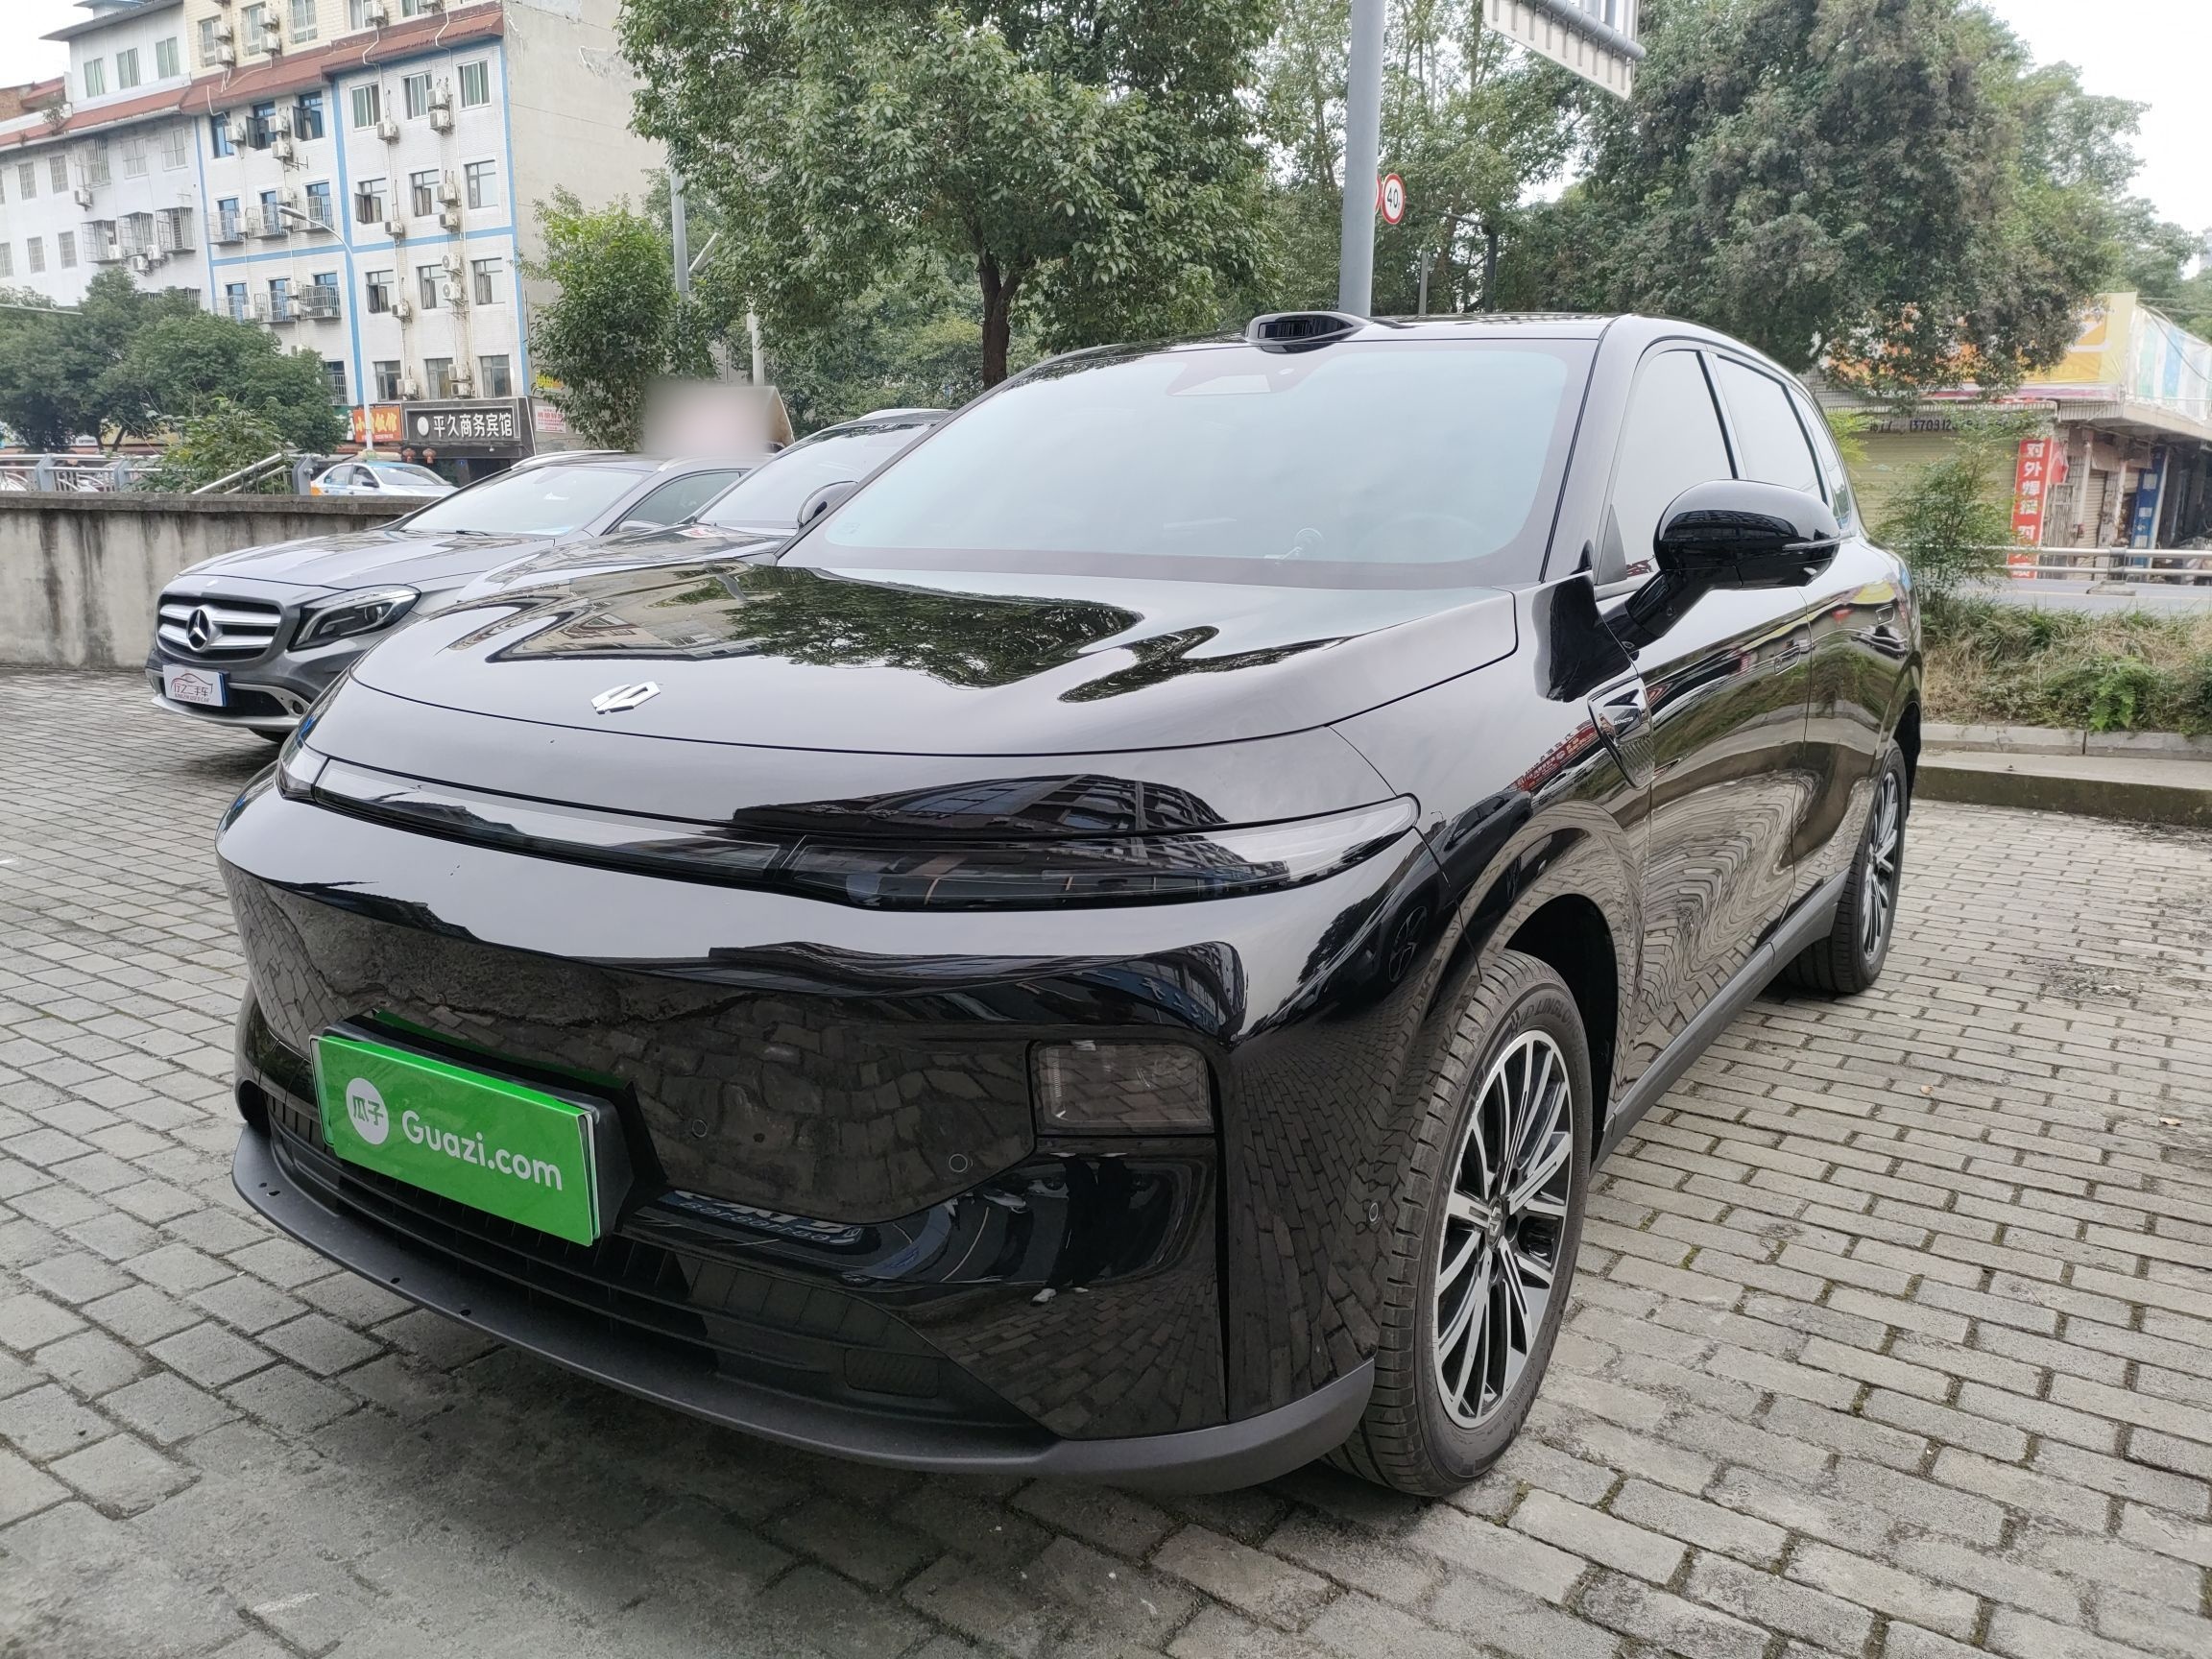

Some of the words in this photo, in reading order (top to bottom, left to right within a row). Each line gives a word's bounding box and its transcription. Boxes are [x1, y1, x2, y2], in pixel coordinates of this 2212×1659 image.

[433, 413, 513, 438] 平久商务宾馆
[351, 1094, 384, 1126] 瓜子
[401, 1110, 563, 1191] Guazi.com
